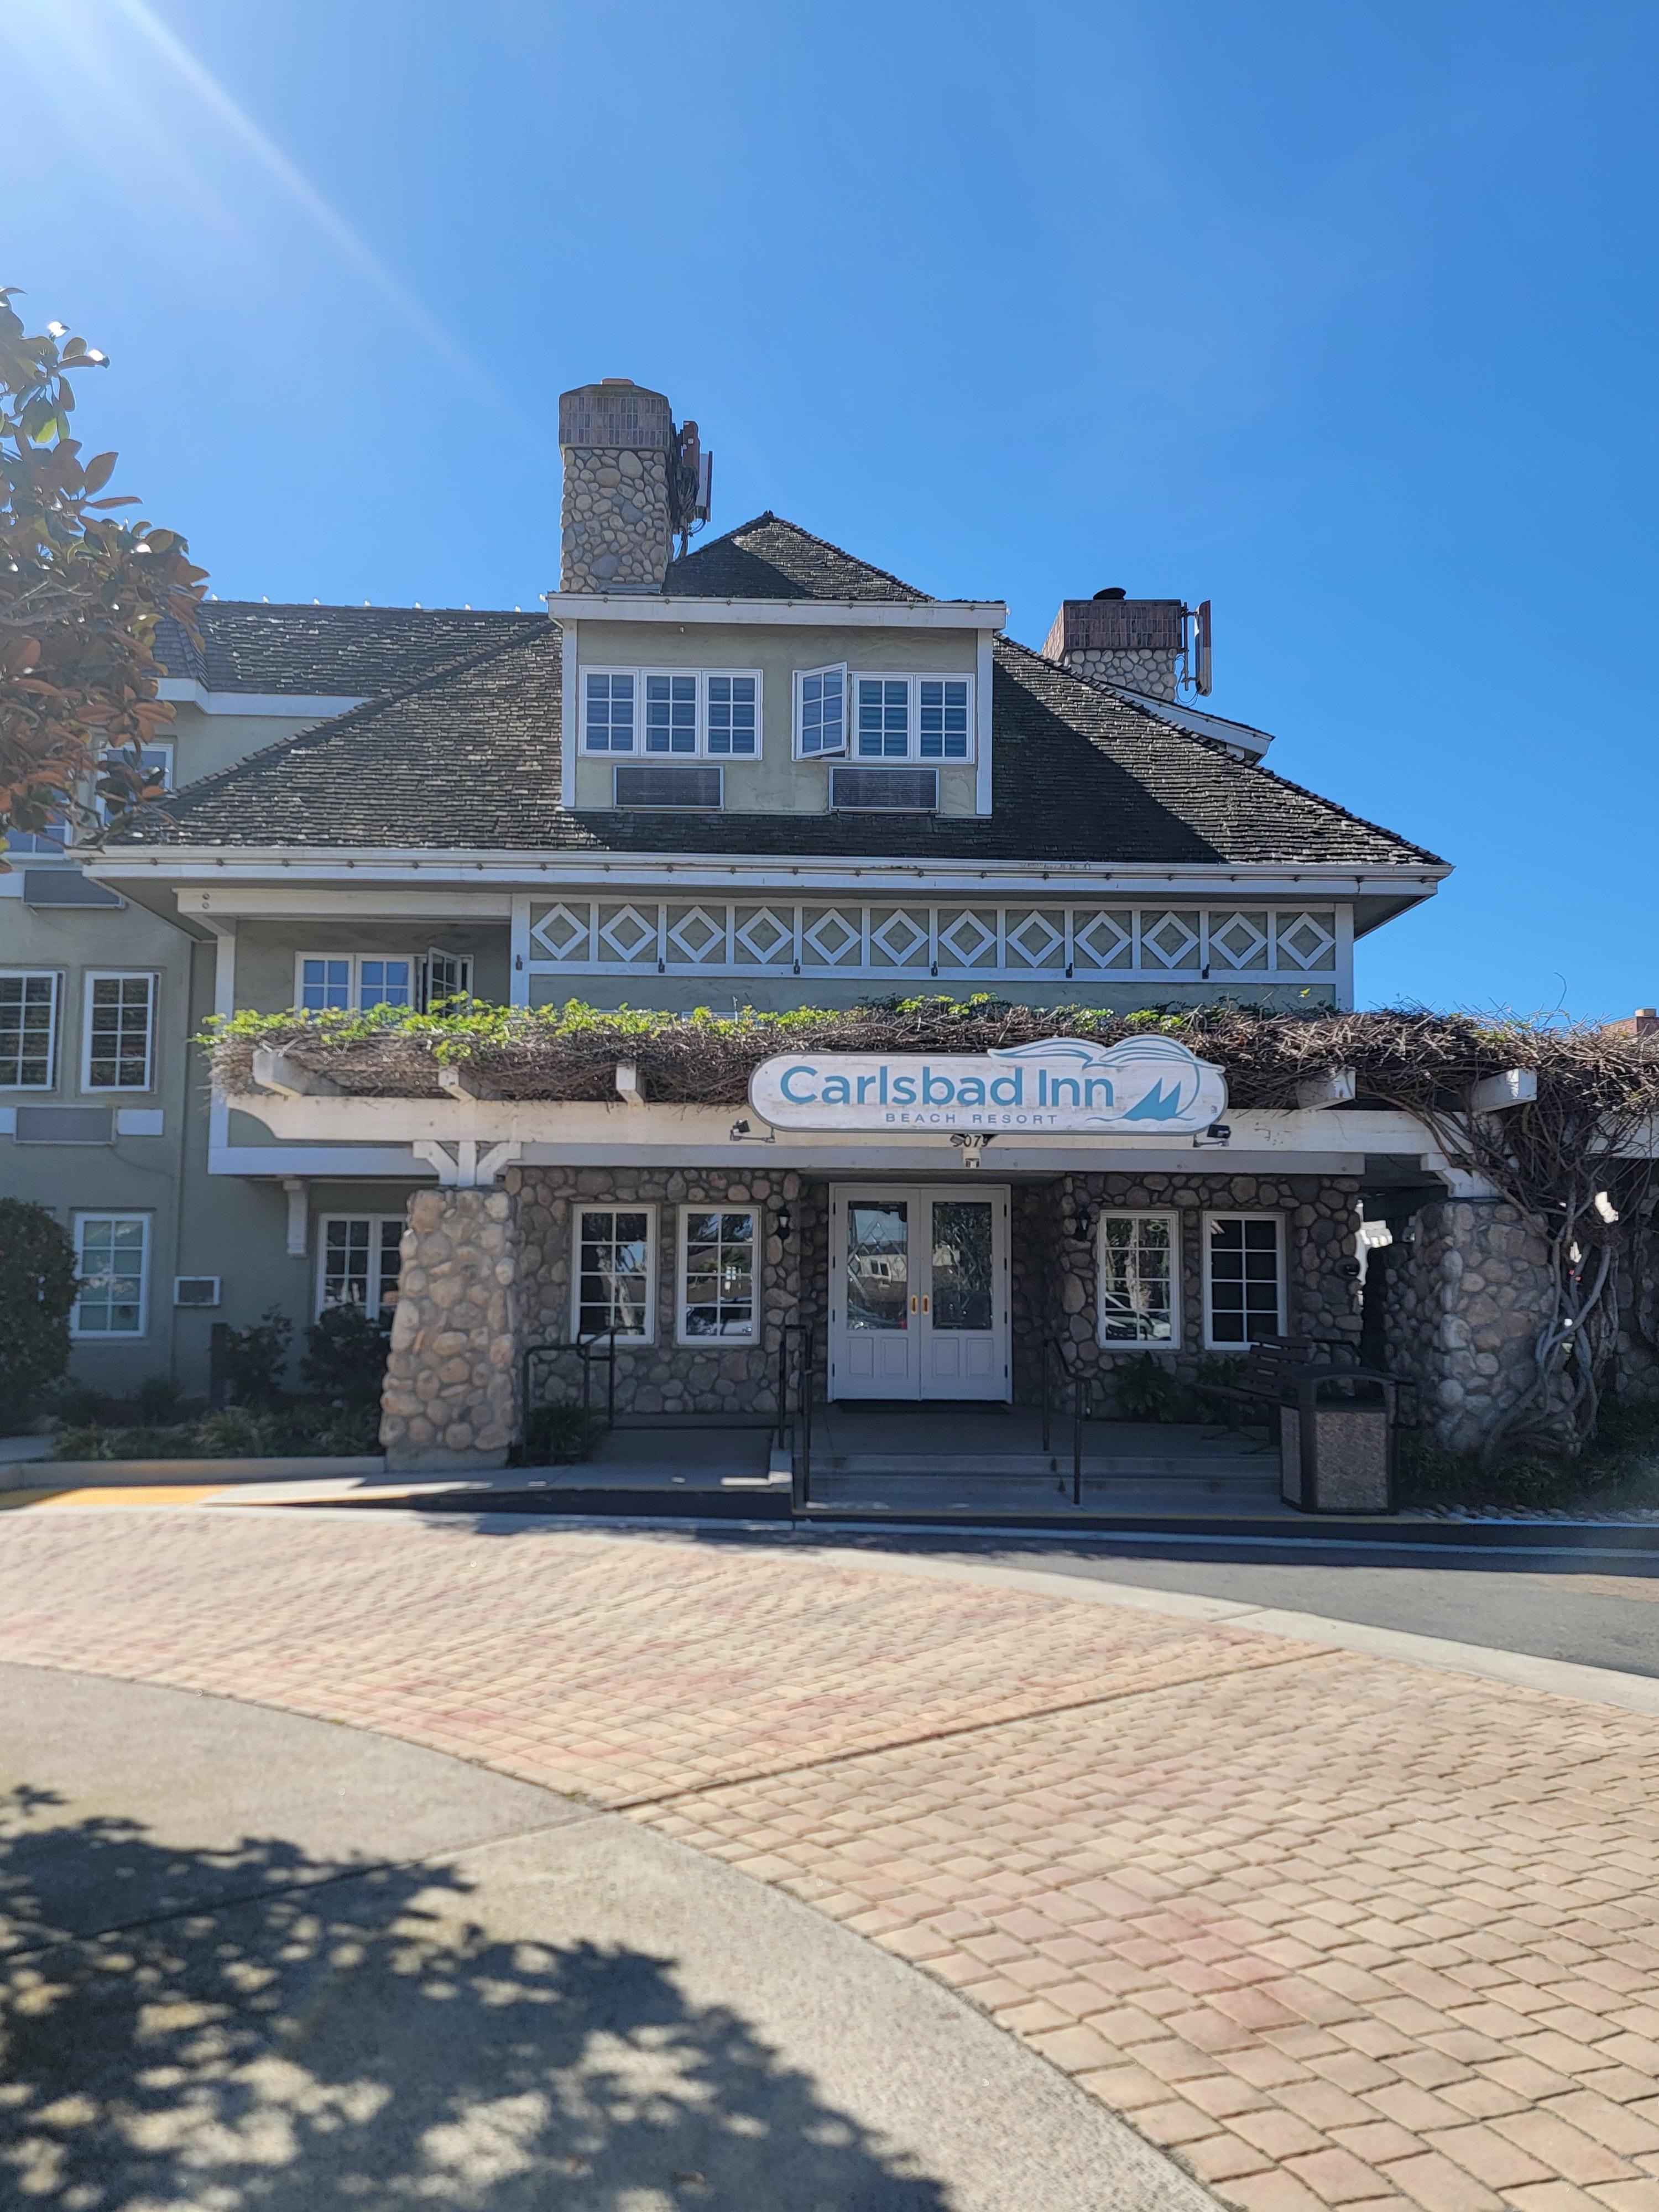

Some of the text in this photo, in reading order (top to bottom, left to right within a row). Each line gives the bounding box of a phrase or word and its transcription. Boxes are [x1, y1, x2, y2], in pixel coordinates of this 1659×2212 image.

[780, 1066, 1114, 1107] Carlsbad Inn
[885, 1113, 1057, 1125] BEACH RESORT
[952, 1134, 989, 1147] 079
